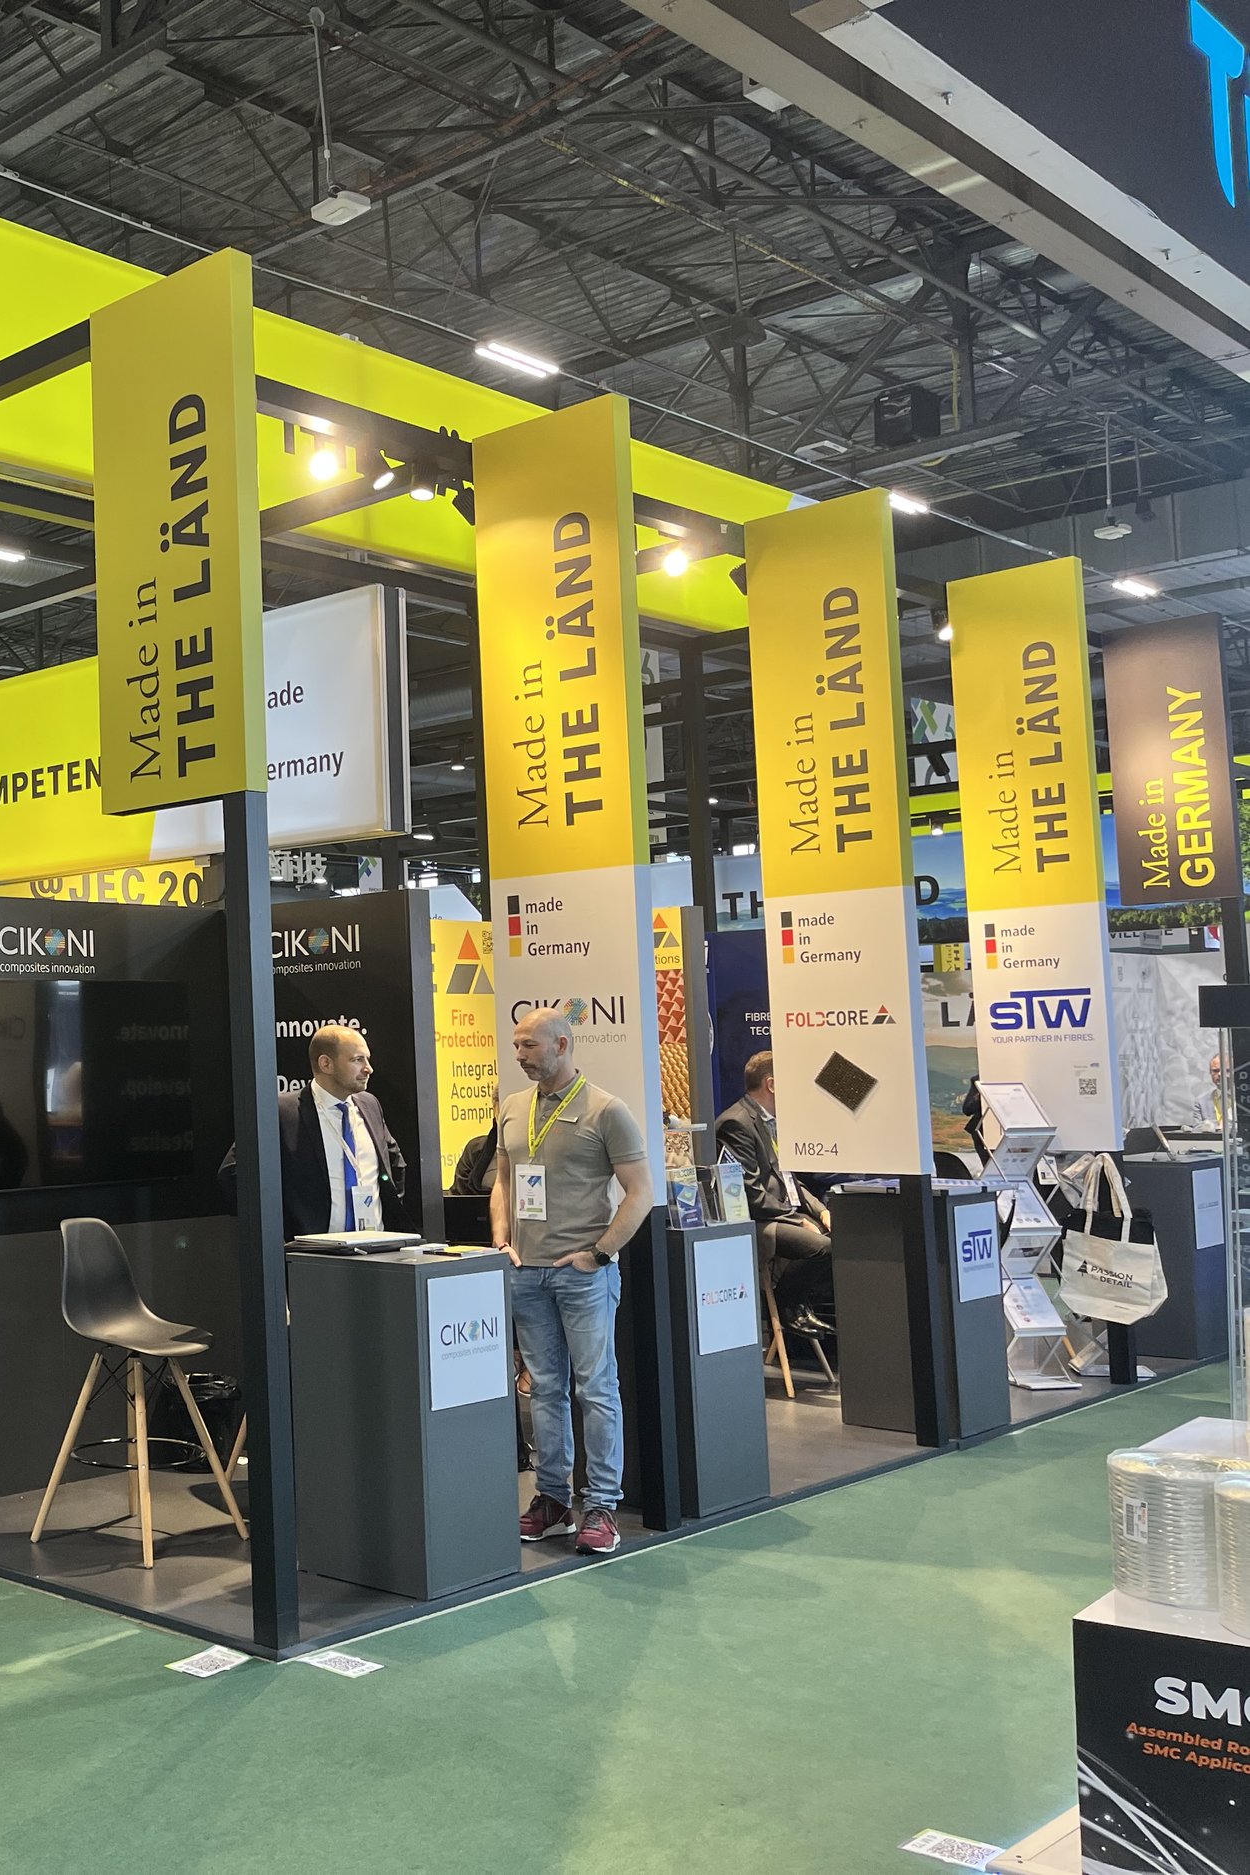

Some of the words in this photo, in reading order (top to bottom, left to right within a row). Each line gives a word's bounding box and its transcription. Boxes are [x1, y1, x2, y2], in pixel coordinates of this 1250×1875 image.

[159, 394, 210, 603] LÄND
[128, 577, 158, 628] in
[545, 512, 597, 680] LÄND
[815, 586, 865, 730] LÄND
[515, 660, 543, 701] in
[176, 626, 215, 778] THE
[268, 681, 304, 709] ade
[1015, 641, 1061, 763] LÄND
[126, 641, 161, 784] Made
[786, 713, 815, 746] in
[267, 751, 344, 780] ermany
[513, 713, 549, 831] Made
[561, 702, 603, 827] THE
[988, 750, 1015, 781] in
[1139, 778, 1163, 805] in
[1166, 686, 1216, 887] GERMANY
[784, 757, 821, 856] Made
[832, 748, 873, 854] THE
[987, 789, 1022, 876] Made
[1032, 782, 1070, 873] THE
[1138, 812, 1170, 889] Made
[69, 869, 145, 904] JEC
[525, 897, 564, 914] made
[722, 891, 764, 920] TH
[526, 922, 538, 935] in
[797, 912, 834, 928] made
[1000, 924, 1035, 937] made
[527, 941, 590, 956] Germany
[798, 932, 811, 945] in
[1001, 941, 1013, 953] in
[0, 963, 49, 975] composites
[51, 963, 95, 974] innovation
[272, 963, 313, 976] omposites
[315, 961, 361, 971] innovation
[799, 948, 861, 965] Germany
[1003, 955, 1060, 970] Germany
[452, 1010, 475, 1026] Fire
[786, 1008, 869, 1028] FOLDCORE
[989, 988, 1091, 1031] STW
[434, 1031, 494, 1048] Protection
[992, 1035, 1013, 1044] YOUR
[1014, 1034, 1053, 1043] PARTNER
[1054, 1034, 1062, 1042] IN
[1064, 1034, 1095, 1042] FIBRES.
[453, 1062, 498, 1079] Integral
[451, 1083, 494, 1100] Acousti
[451, 1107, 494, 1124] Dampin
[795, 1142, 838, 1156] M82-4
[962, 1229, 992, 1262] STW
[1091, 1265, 1133, 1280] PASSION
[1100, 1276, 1132, 1288] DETAIL
[1126, 1722, 1222, 1750] Assembled
[1143, 1742, 1181, 1760] SMC
